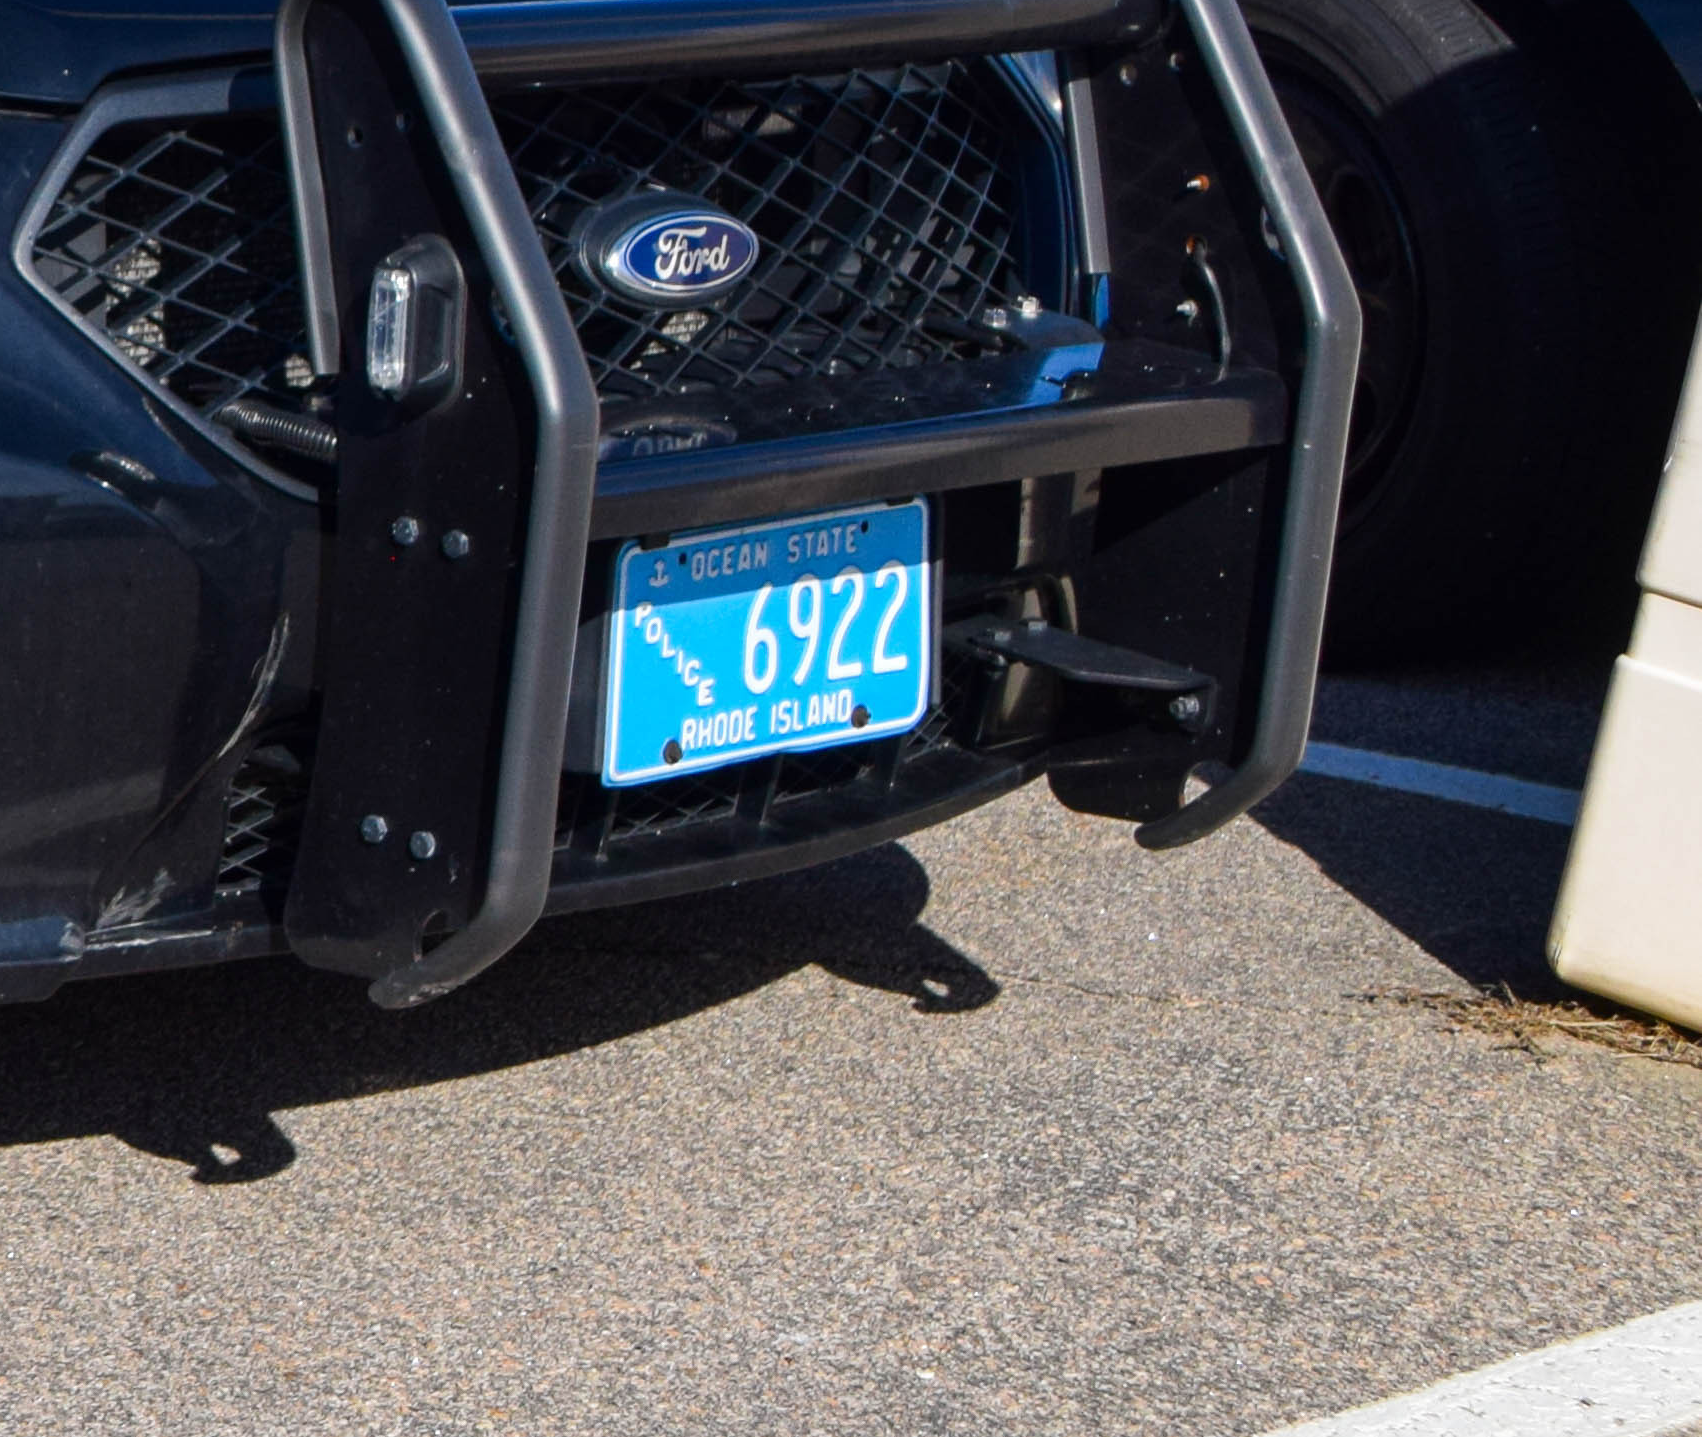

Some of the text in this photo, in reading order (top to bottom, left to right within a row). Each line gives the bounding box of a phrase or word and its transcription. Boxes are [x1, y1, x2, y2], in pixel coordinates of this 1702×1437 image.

[654, 226, 730, 281] Ford
[690, 523, 859, 581] OCEAN STATE
[633, 601, 716, 707] POLICE
[743, 560, 909, 695] 6922
[680, 688, 854, 751] RHODE ISLAND
